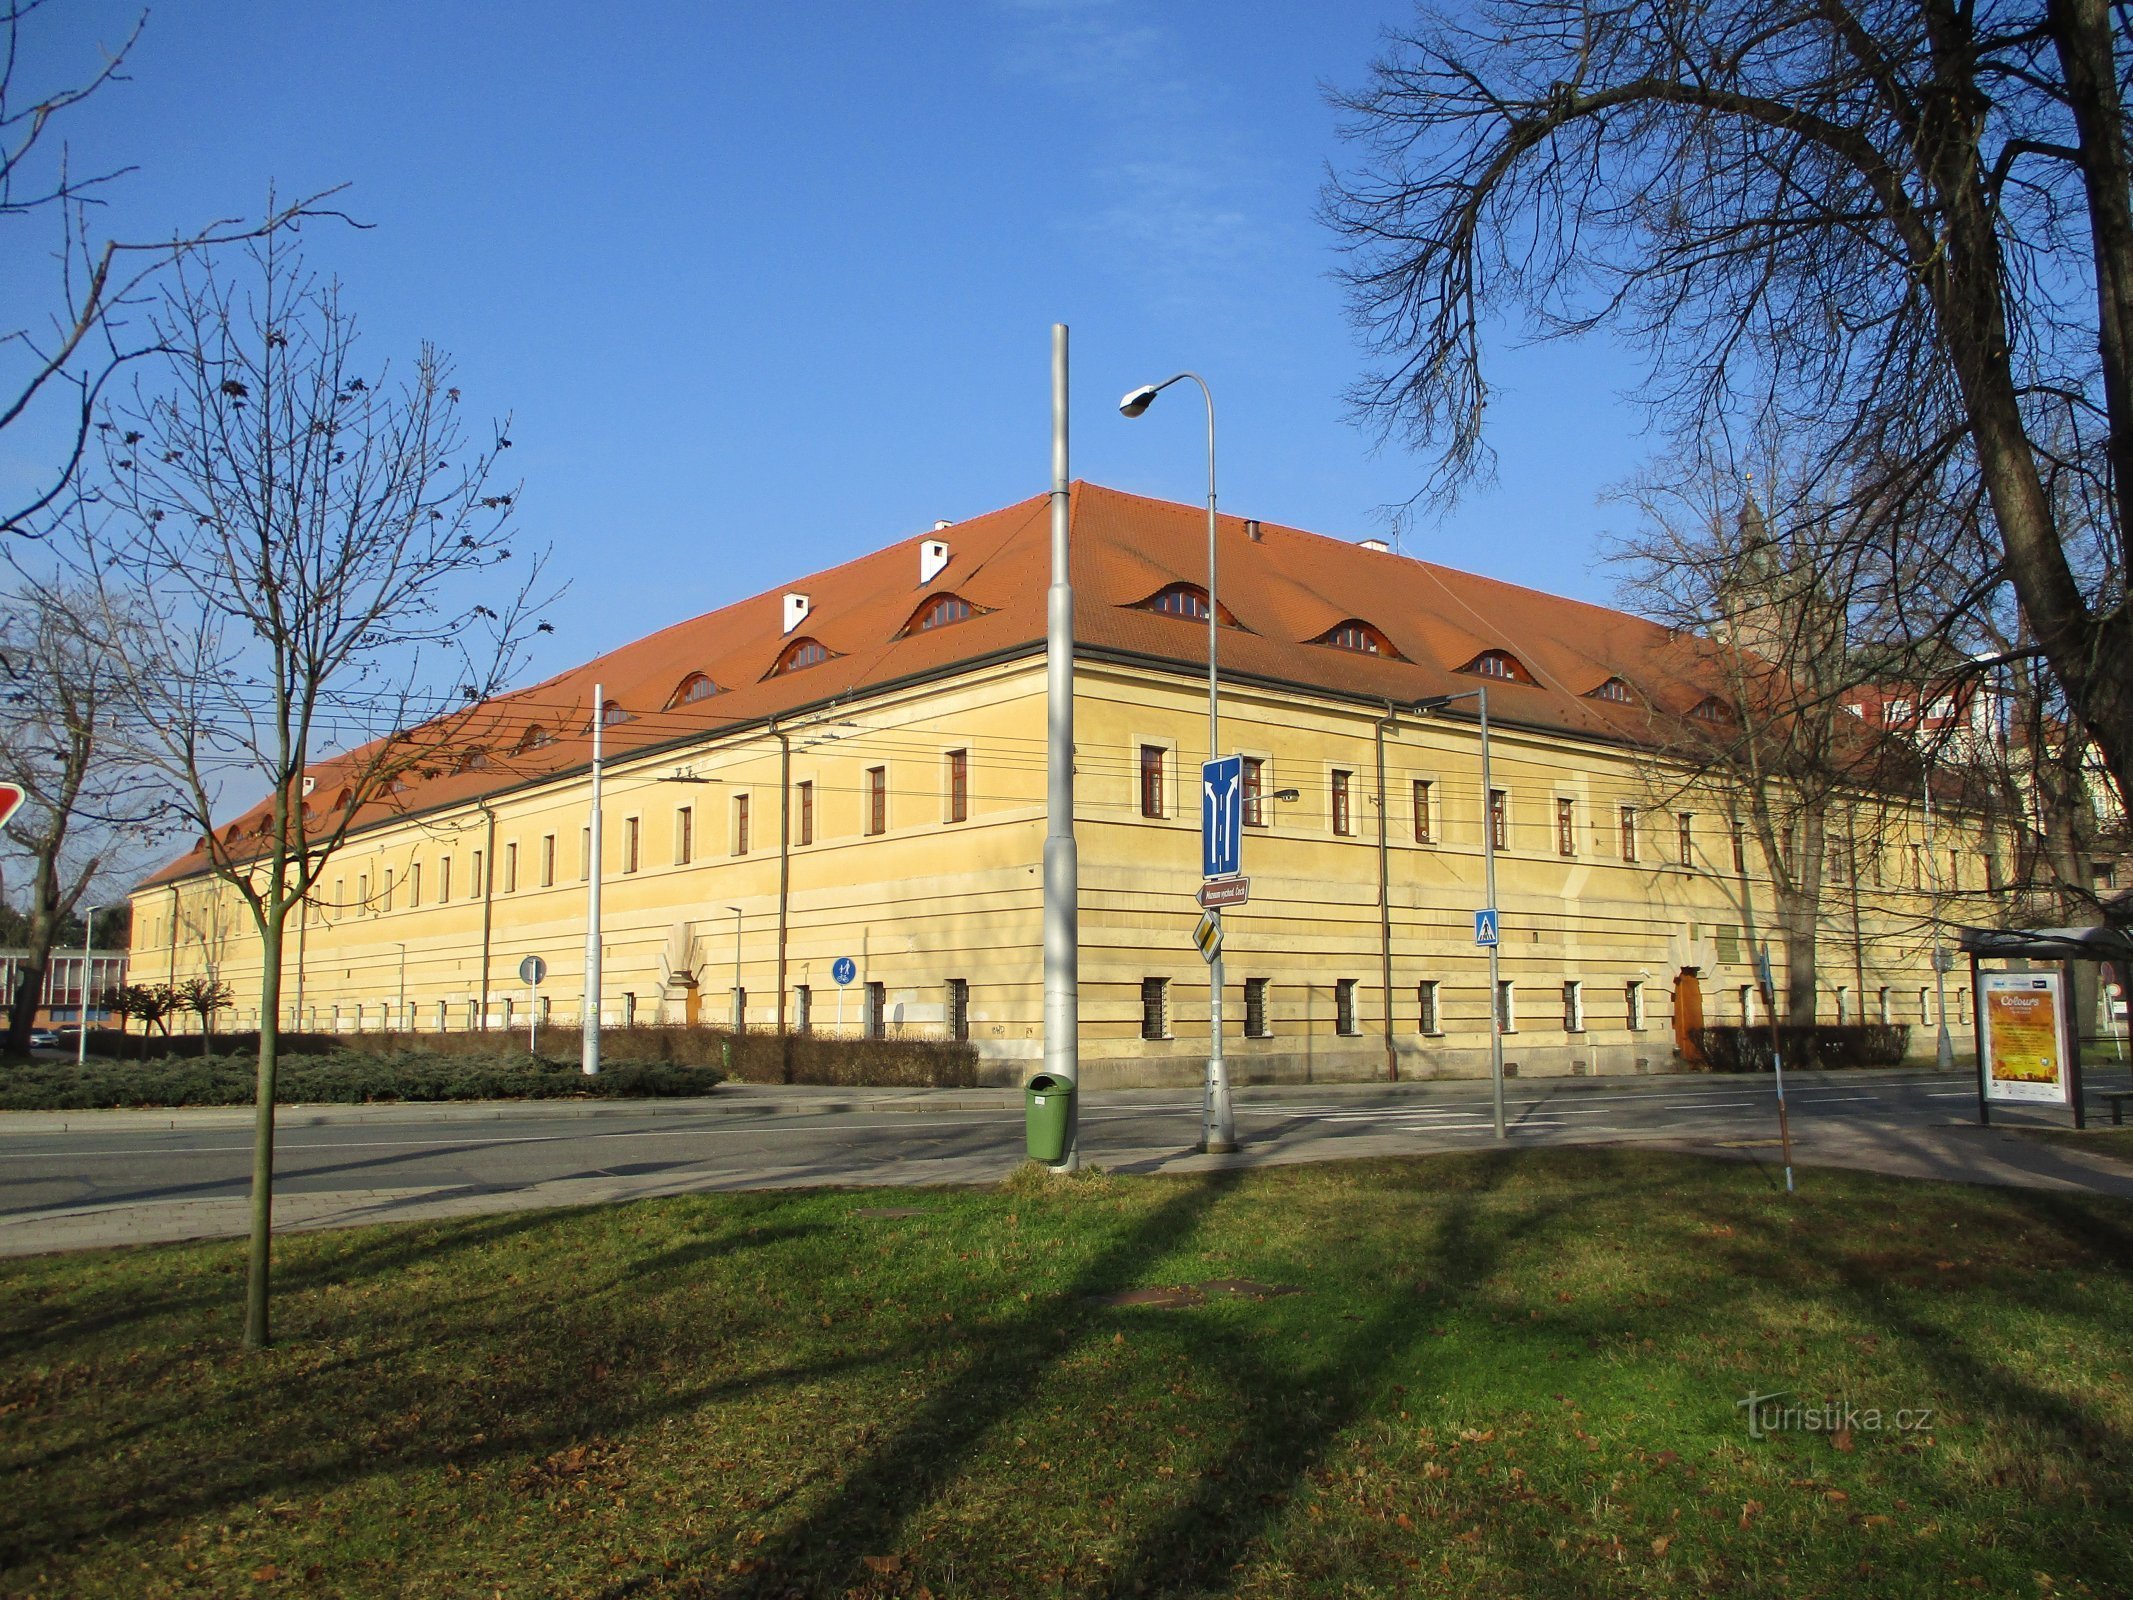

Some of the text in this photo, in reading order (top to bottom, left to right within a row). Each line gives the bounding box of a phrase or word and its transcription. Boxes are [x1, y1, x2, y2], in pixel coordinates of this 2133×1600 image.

[1206, 890, 1221, 900] Muzeum
[1235, 884, 1245, 896] Čech
[2000, 995, 2040, 1006] Colours
